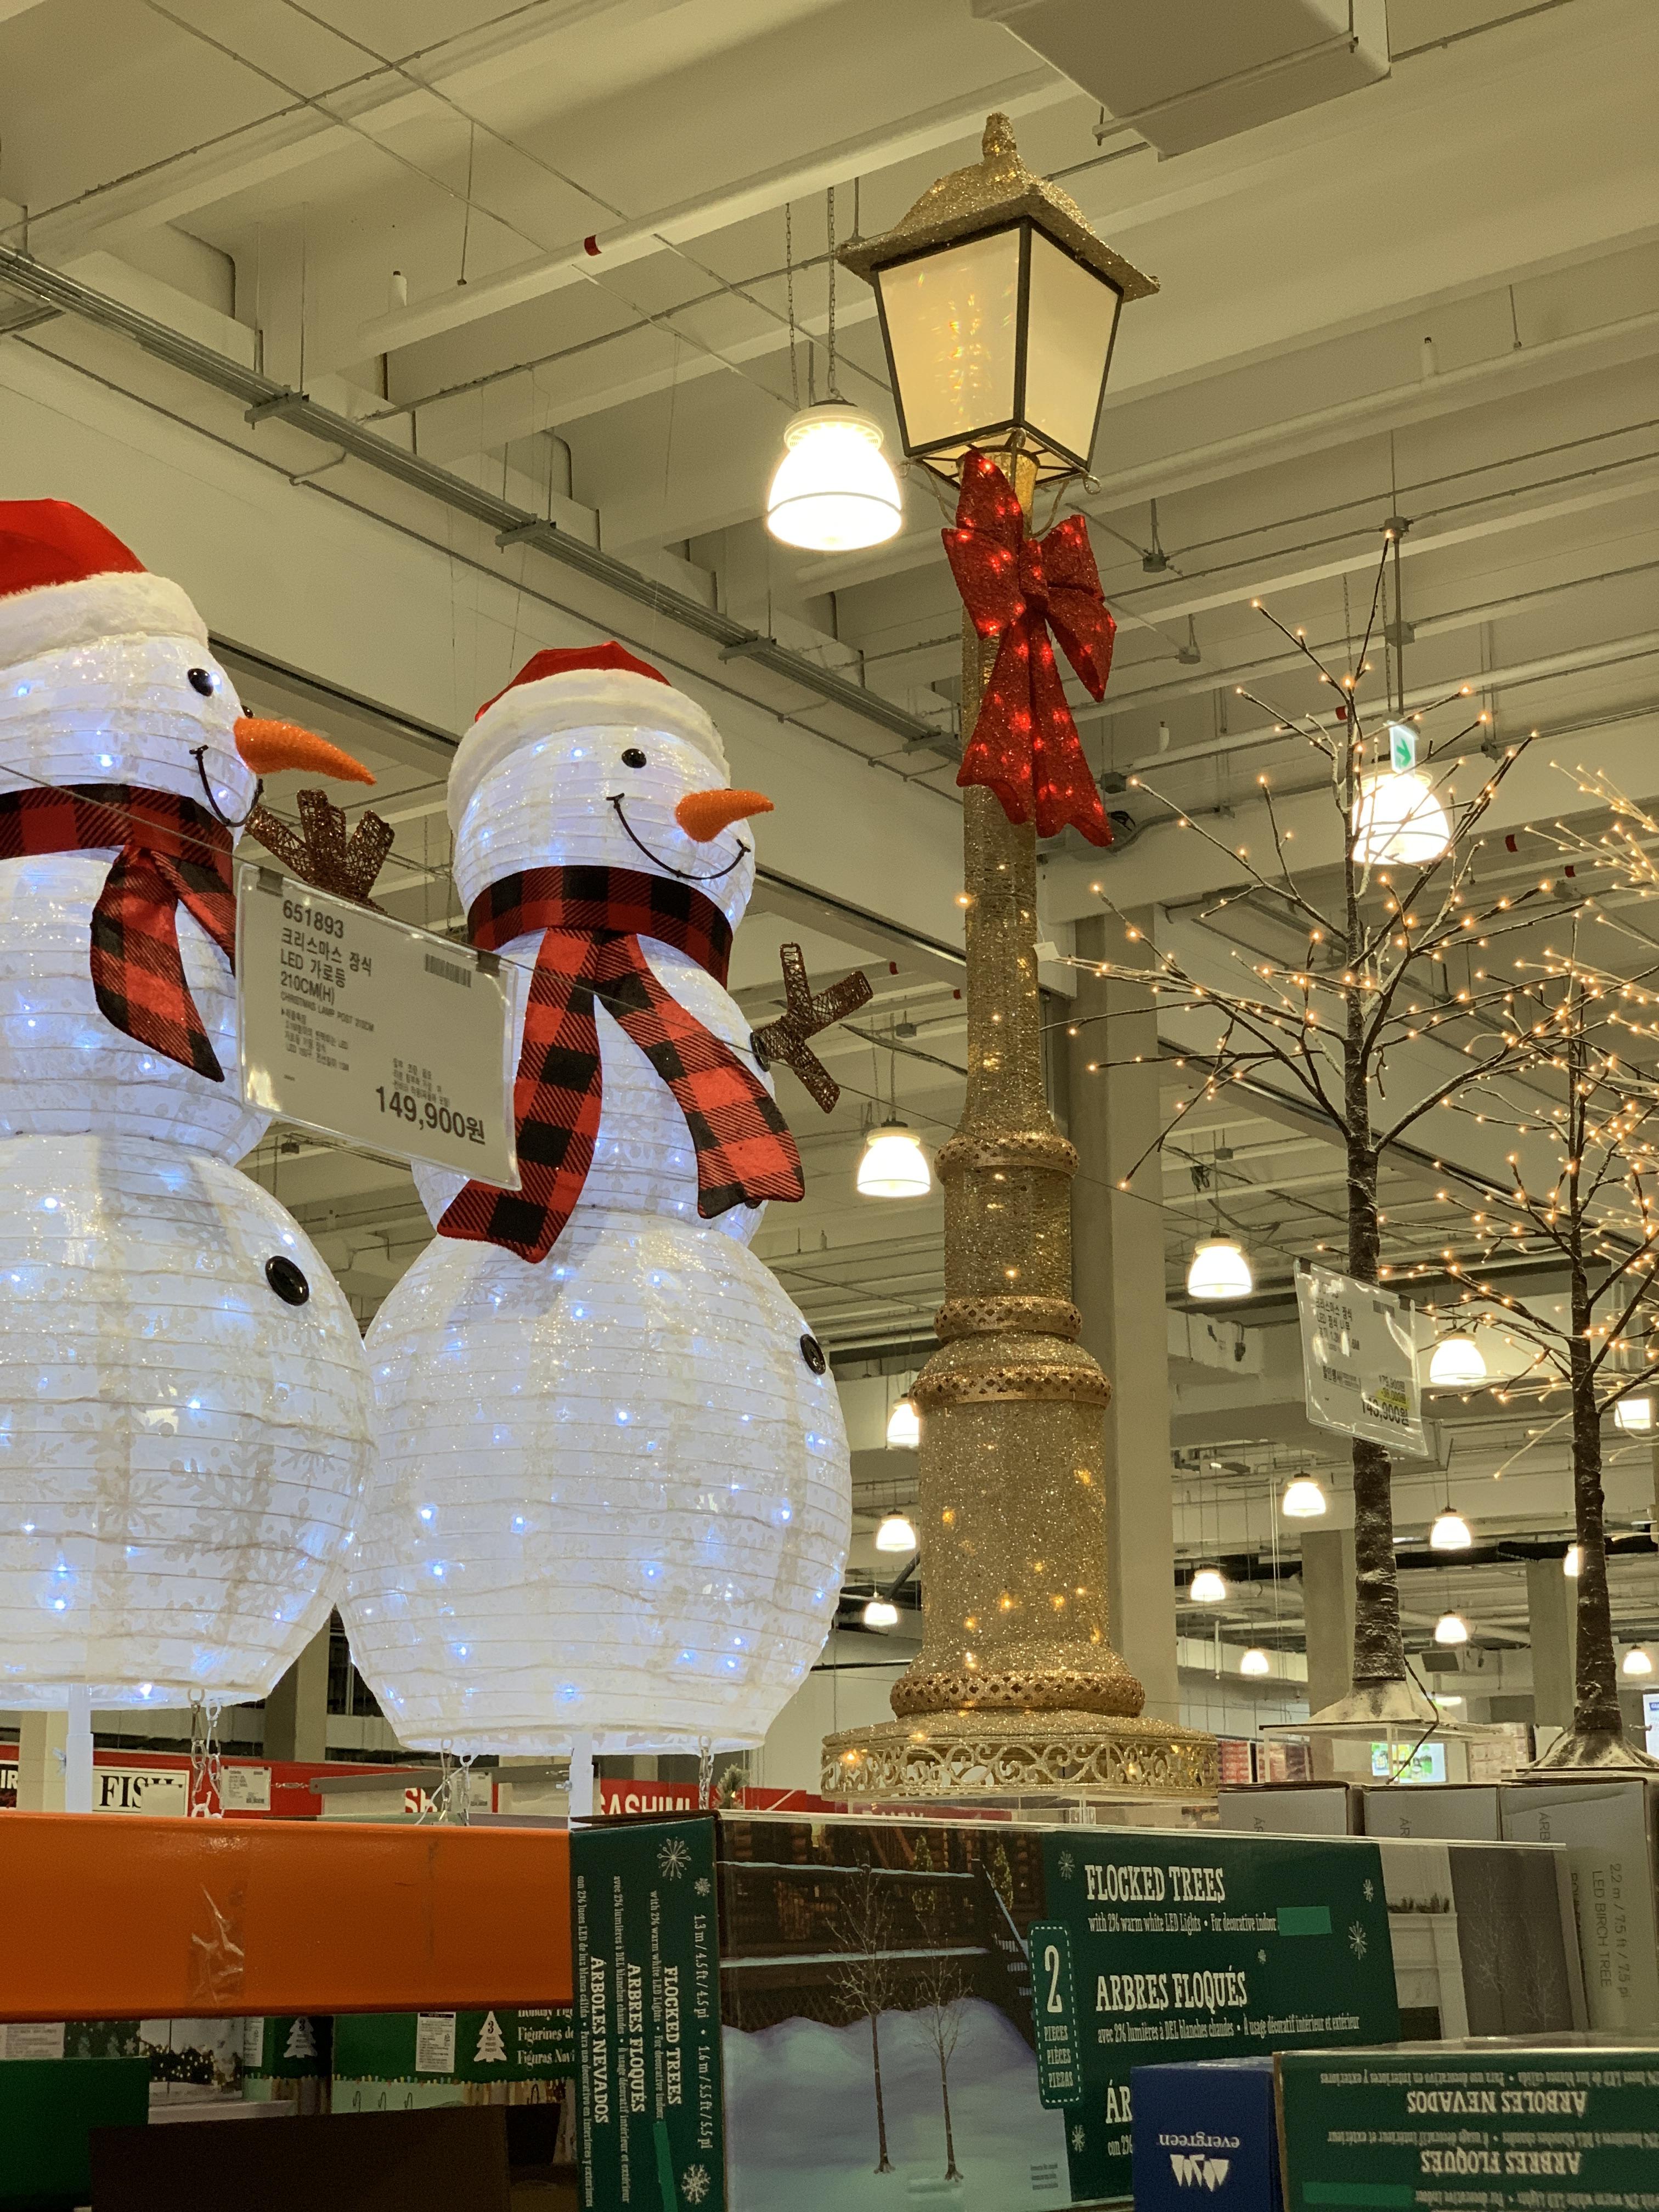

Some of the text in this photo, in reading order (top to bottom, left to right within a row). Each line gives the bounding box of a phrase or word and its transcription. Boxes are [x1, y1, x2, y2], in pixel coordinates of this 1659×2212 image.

[283, 900, 343, 939] 651893
[281, 927, 372, 977] 크리스마스 장식
[280, 948, 346, 988] LED 가로등
[280, 971, 335, 1005] 210CM(H)
[376, 1086, 485, 1146] 149,900원
[613, 1876, 622, 1893] avec
[1085, 1865, 1225, 1903] FLOCKED TREES
[650, 1891, 660, 1910] with
[578, 1905, 587, 1923] luces
[693, 1915, 706, 1929] 1.3
[1088, 1912, 1107, 1932] with
[1120, 1918, 1143, 1932] warm
[1143, 1912, 1164, 1932] white
[1164, 1913, 1178, 1931] LED
[1180, 1912, 1201, 1936] Lights
[1211, 1913, 1221, 1931] For
[1223, 1912, 1255, 1931] decorative
[1256, 1912, 1277, 1931] indoor
[578, 1926, 587, 1941] LED
[614, 1909, 624, 1944] lumières
[695, 1931, 704, 1942] m
[1592, 1871, 1612, 1988] LED BIRCH TREE
[579, 1943, 588, 1951] de
[579, 1953, 588, 1966] luz
[652, 1953, 661, 1976] white
[696, 1953, 707, 1967] 4.5
[579, 1967, 588, 1993] blanca
[616, 1969, 624, 2002] blanches
[696, 1971, 708, 1979] ft
[1045, 1945, 1062, 2012] 2
[653, 1979, 662, 1995] LED
[697, 1990, 709, 2005] 4.5
[1096, 1965, 1248, 2015] ARBRES FLOQUÉS
[580, 1994, 589, 2018] cálida
[651, 1997, 663, 2022] Lights
[693, 2008, 709, 2018] pi
[488, 2021, 494, 2034] 3
[617, 2004, 626, 2034] chaudes
[518, 2027, 562, 2047] Figurines
[590, 1956, 608, 2123] ÁRBOLES NEVADOS
[628, 1963, 647, 2112] ARBRES FLOQUÉS
[664, 1966, 681, 2104] FLOCKED TREES
[1044, 2025, 1068, 2041] PIECES
[1098, 2029, 1113, 2044] avec
[1126, 2022, 1158, 2041] lumières
[1165, 2021, 1179, 2040] DEL
[1180, 2019, 1207, 2038] blanches
[1209, 2018, 1234, 2037] chaudes
[1249, 2019, 1266, 2039] usage
[517, 2049, 552, 2071] Figuras
[698, 2046, 710, 2060] 1.6
[1047, 2045, 1071, 2064] PIÈCES
[617, 2055, 626, 2075] usage
[654, 2050, 664, 2091] decorative
[699, 2063, 708, 2073] m
[582, 2064, 591, 2104] decorativo
[1048, 2072, 1073, 2087] PIEZAS
[699, 2085, 712, 2098] 5.5
[656, 2093, 665, 2119] indoor
[700, 2101, 712, 2111] ft
[1406, 2090, 1588, 2119] ÁRBOLES NEVADOS
[700, 2121, 713, 2135] 5.5
[698, 2138, 713, 2149] pi
[1159, 2131, 1240, 2148] evergreen
[1419, 2146, 1582, 2177] ARBRES FLOQUÉS
